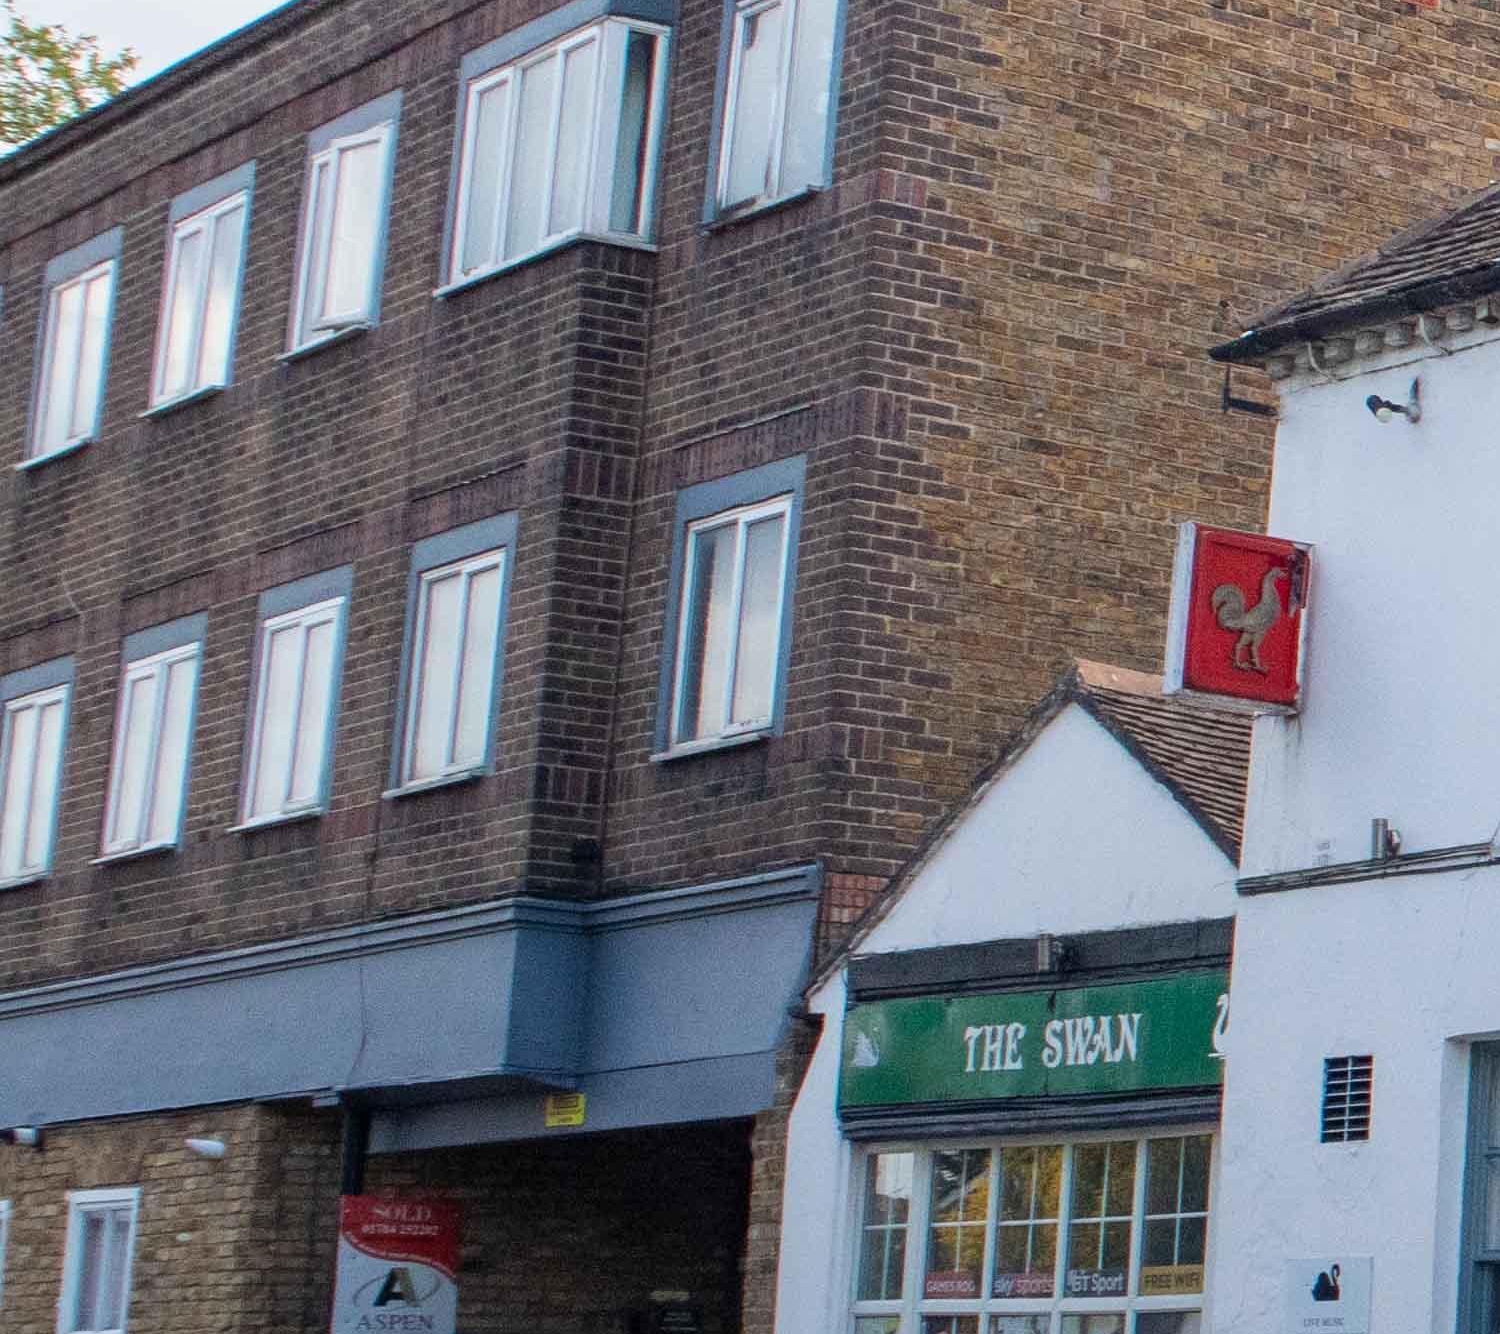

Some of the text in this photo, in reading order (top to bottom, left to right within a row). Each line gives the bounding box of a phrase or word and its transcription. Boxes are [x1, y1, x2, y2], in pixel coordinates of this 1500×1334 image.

[963, 1013, 1144, 1073] THE SWAN
[372, 1204, 433, 1221] SOLD
[1092, 1272, 1124, 1294] Sport
[1143, 1274, 1172, 1289] FREE
[356, 1314, 434, 1331] ASPEN
